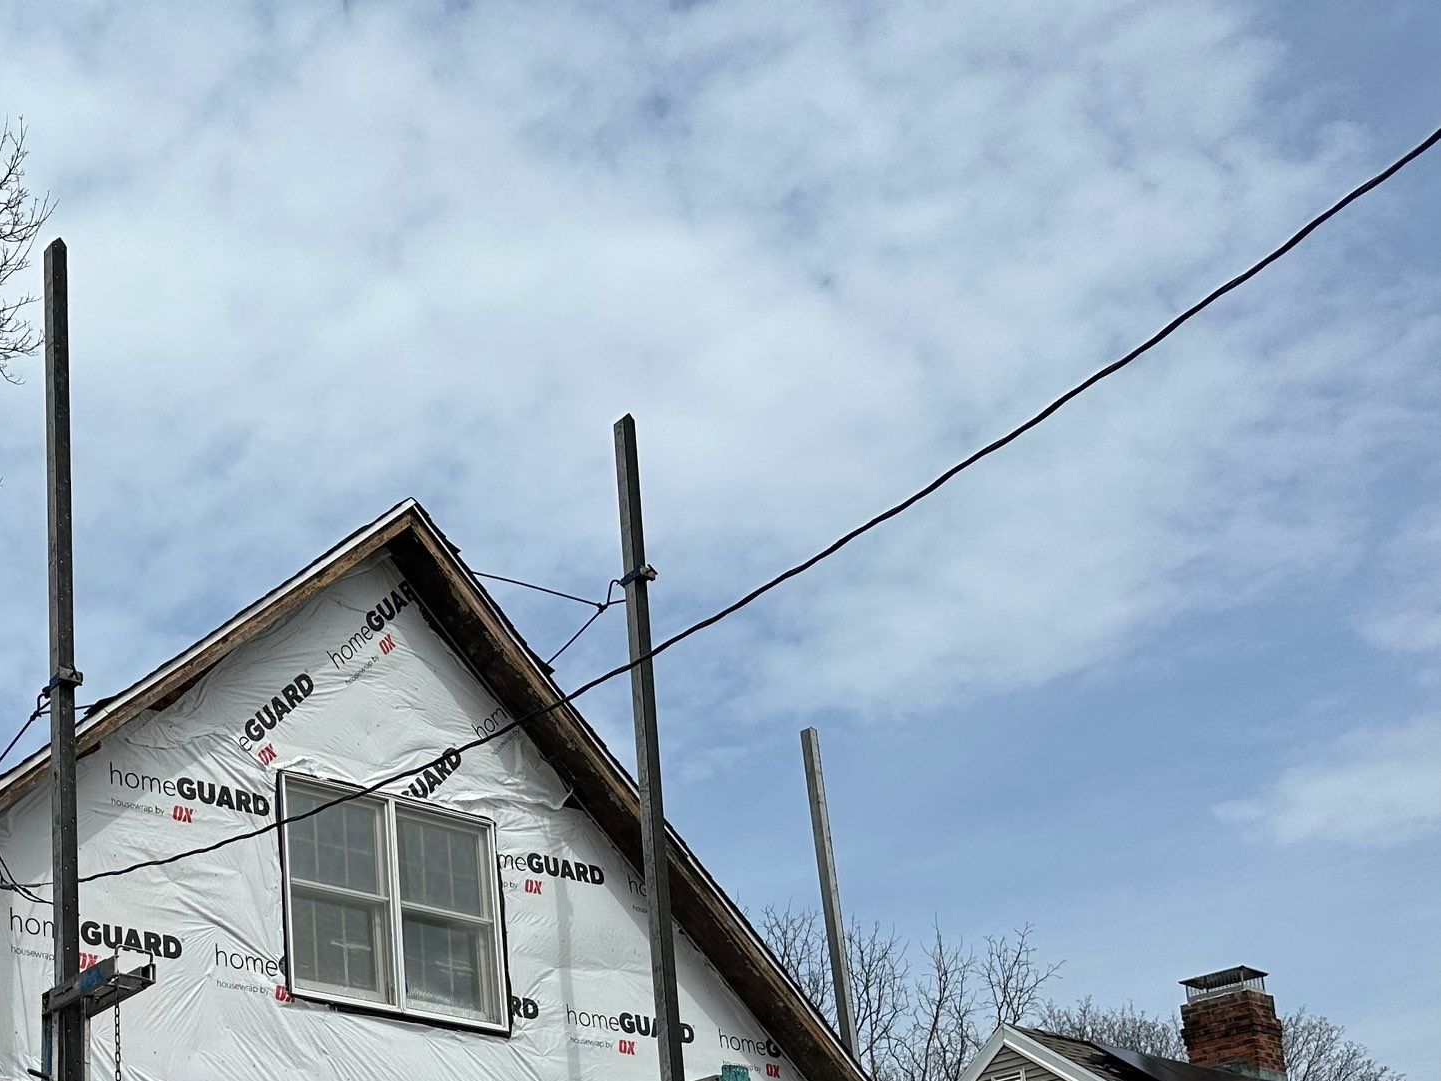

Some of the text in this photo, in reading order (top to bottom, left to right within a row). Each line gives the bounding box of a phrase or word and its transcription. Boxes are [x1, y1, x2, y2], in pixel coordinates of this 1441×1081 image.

[379, 634, 396, 655] OX
[258, 743, 277, 766] OX
[402, 747, 461, 798] UARD
[110, 762, 270, 816] homeGUARD
[112, 798, 194, 823] housewrap by OX
[524, 879, 543, 895] OX
[215, 943, 287, 976] home
[216, 979, 259, 993] housewrap
[275, 985, 295, 1003] O
[618, 1039, 636, 1055] OX
[766, 1063, 780, 1078] OX
